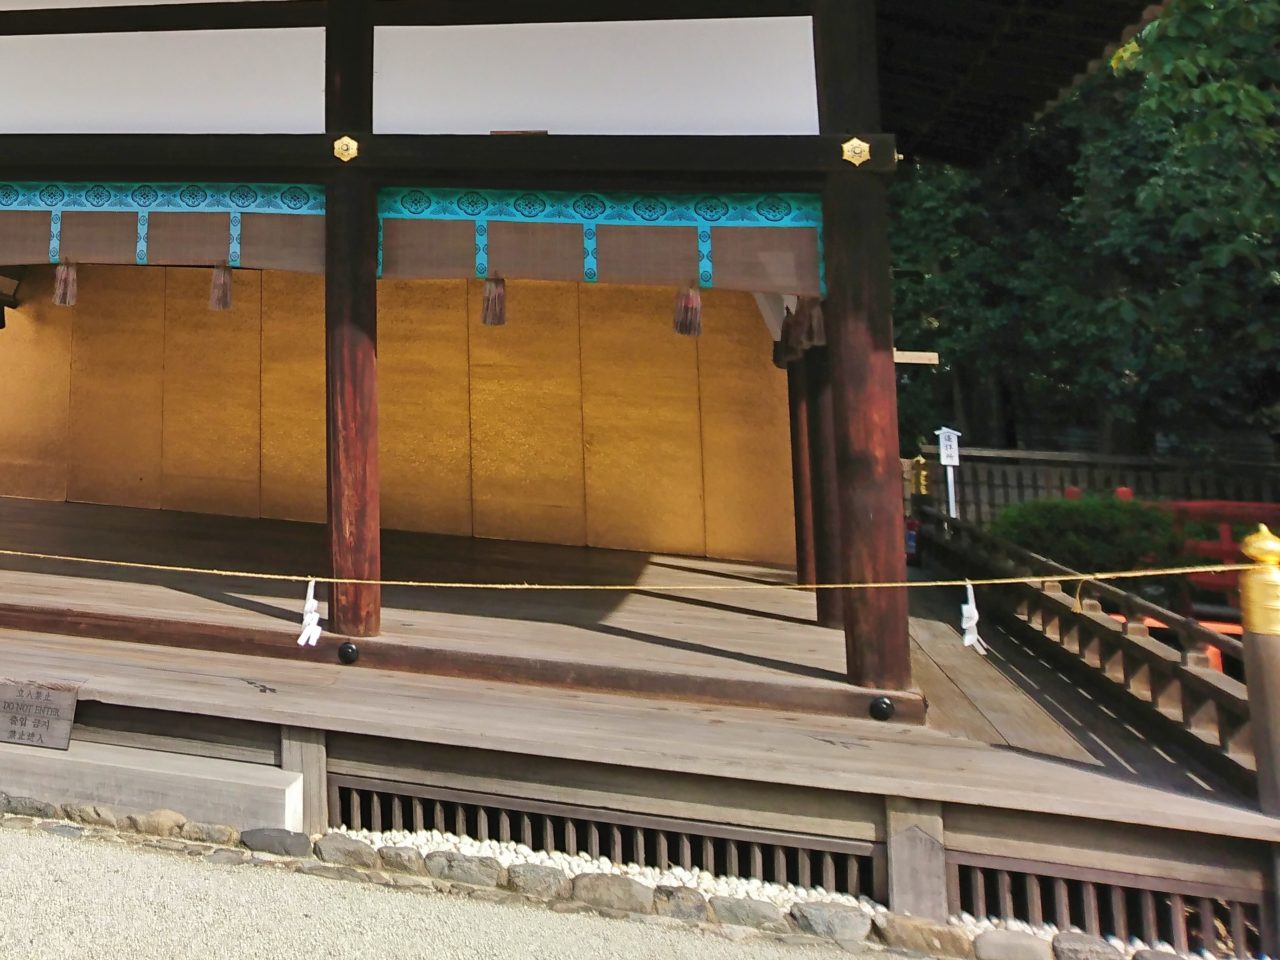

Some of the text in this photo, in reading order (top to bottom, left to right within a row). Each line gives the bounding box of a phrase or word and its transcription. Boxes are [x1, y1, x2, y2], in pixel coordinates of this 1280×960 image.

[16, 688, 52, 701] 立入禁止
[3, 701, 60, 717] DO NOT ENTER
[32, 718, 50, 730] 금지
